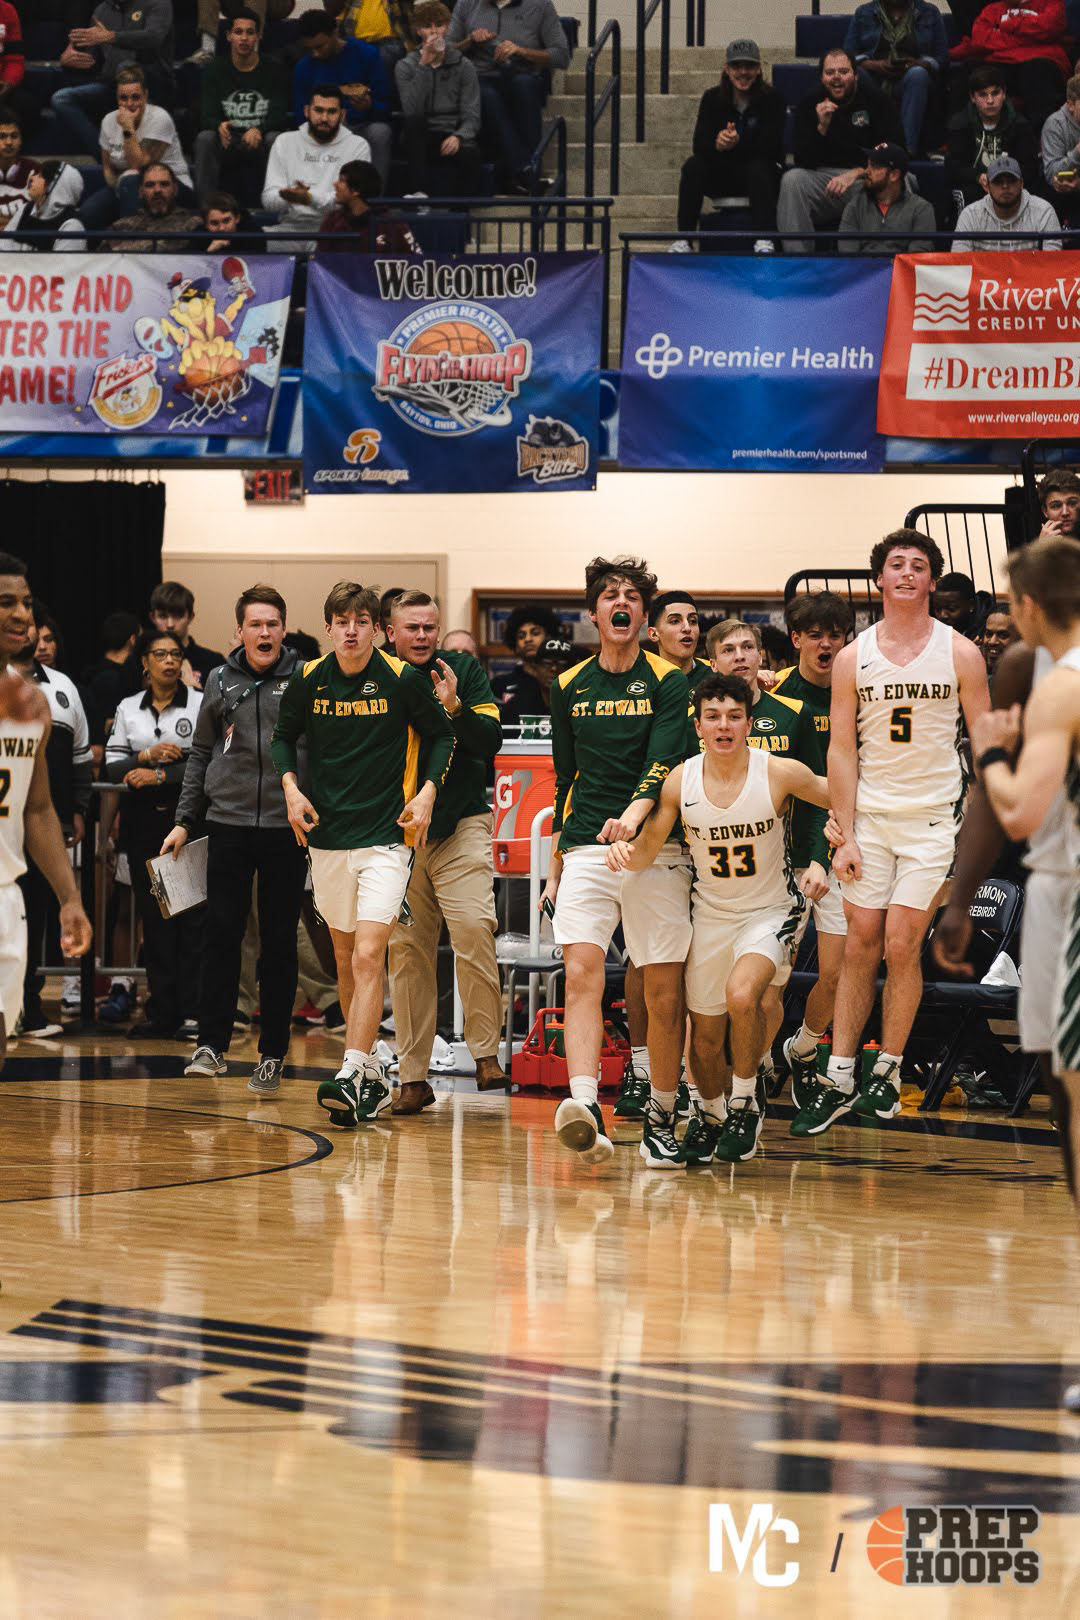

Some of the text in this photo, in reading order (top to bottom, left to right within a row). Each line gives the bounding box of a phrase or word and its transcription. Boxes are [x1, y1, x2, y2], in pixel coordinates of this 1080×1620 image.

[375, 257, 537, 300] Welcome!
[72, 274, 133, 314] AND
[401, 305, 505, 338] PREMIER HEALTH
[977, 316, 1046, 331] CREDIT
[58, 319, 111, 358] THE
[462, 343, 527, 392] HOOP
[688, 345, 874, 369] Premier Health
[968, 411, 1080, 425] www.rivervalleycu.org
[732, 447, 867, 460] premierhealth.com/sportsmed
[884, 683, 951, 700] EDWARD
[313, 698, 388, 716] ST. EDWARD
[571, 701, 592, 717] ST.
[814, 716, 830, 732] ED
[890, 705, 913, 744] 5
[496, 775, 513, 810] G
[709, 818, 774, 841] EDWARD
[708, 844, 757, 879] 33
